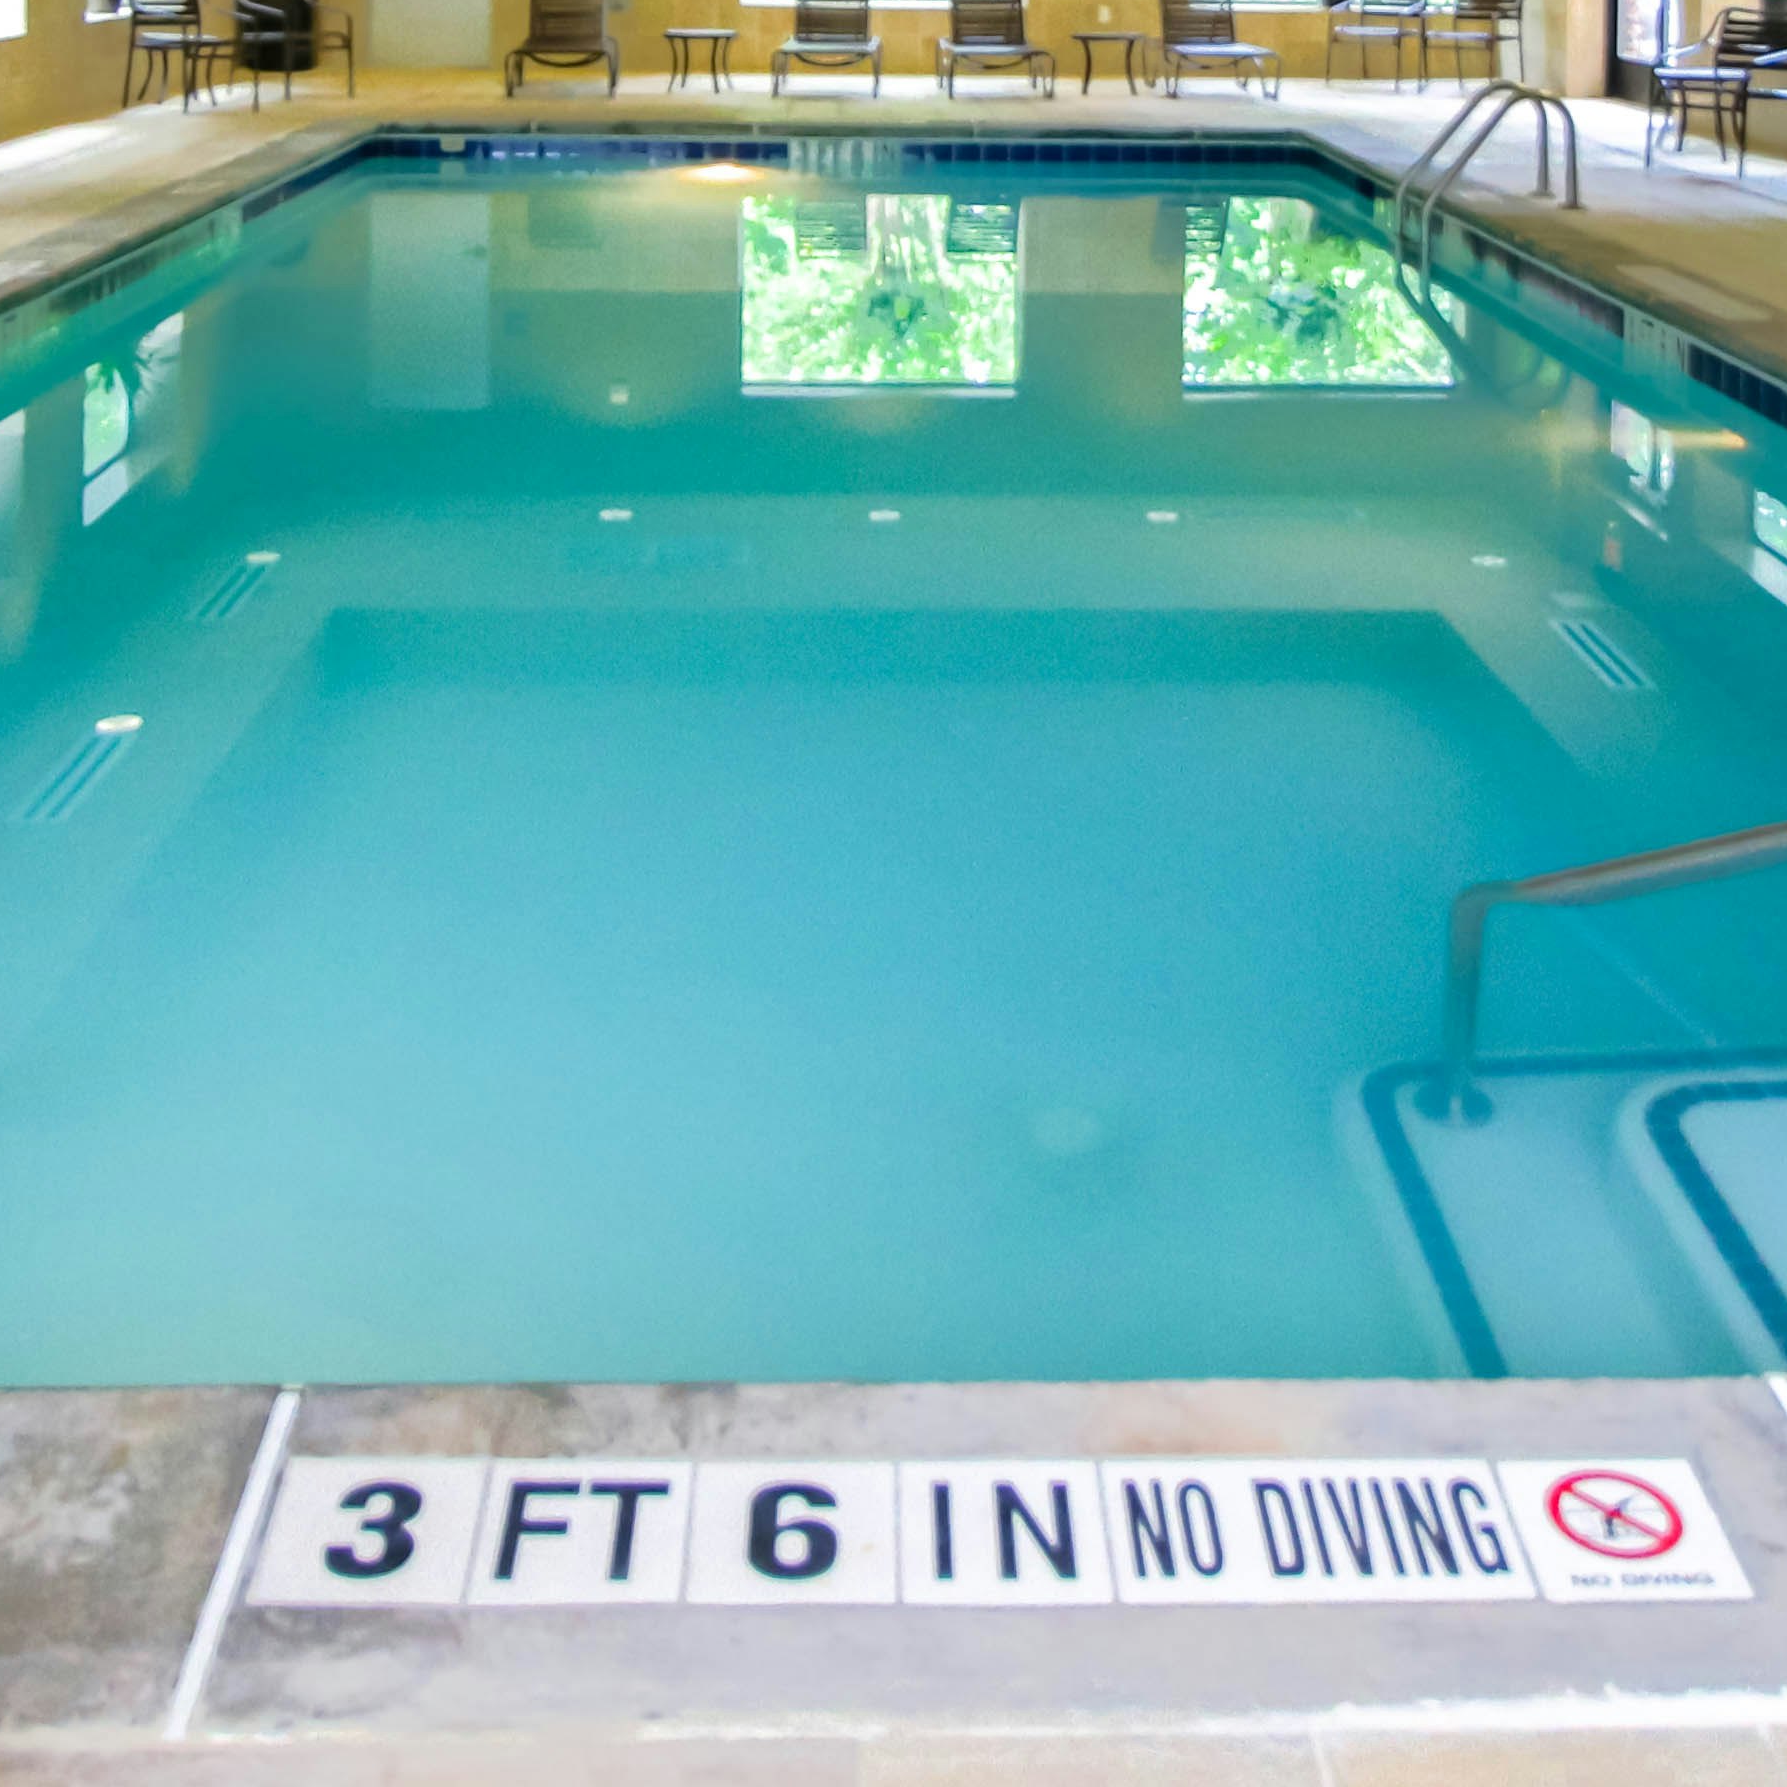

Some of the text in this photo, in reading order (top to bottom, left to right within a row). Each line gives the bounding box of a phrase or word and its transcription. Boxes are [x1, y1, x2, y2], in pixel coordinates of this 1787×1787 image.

[323, 1479, 1511, 1580] 3 FT 6 IN NO DIVING
